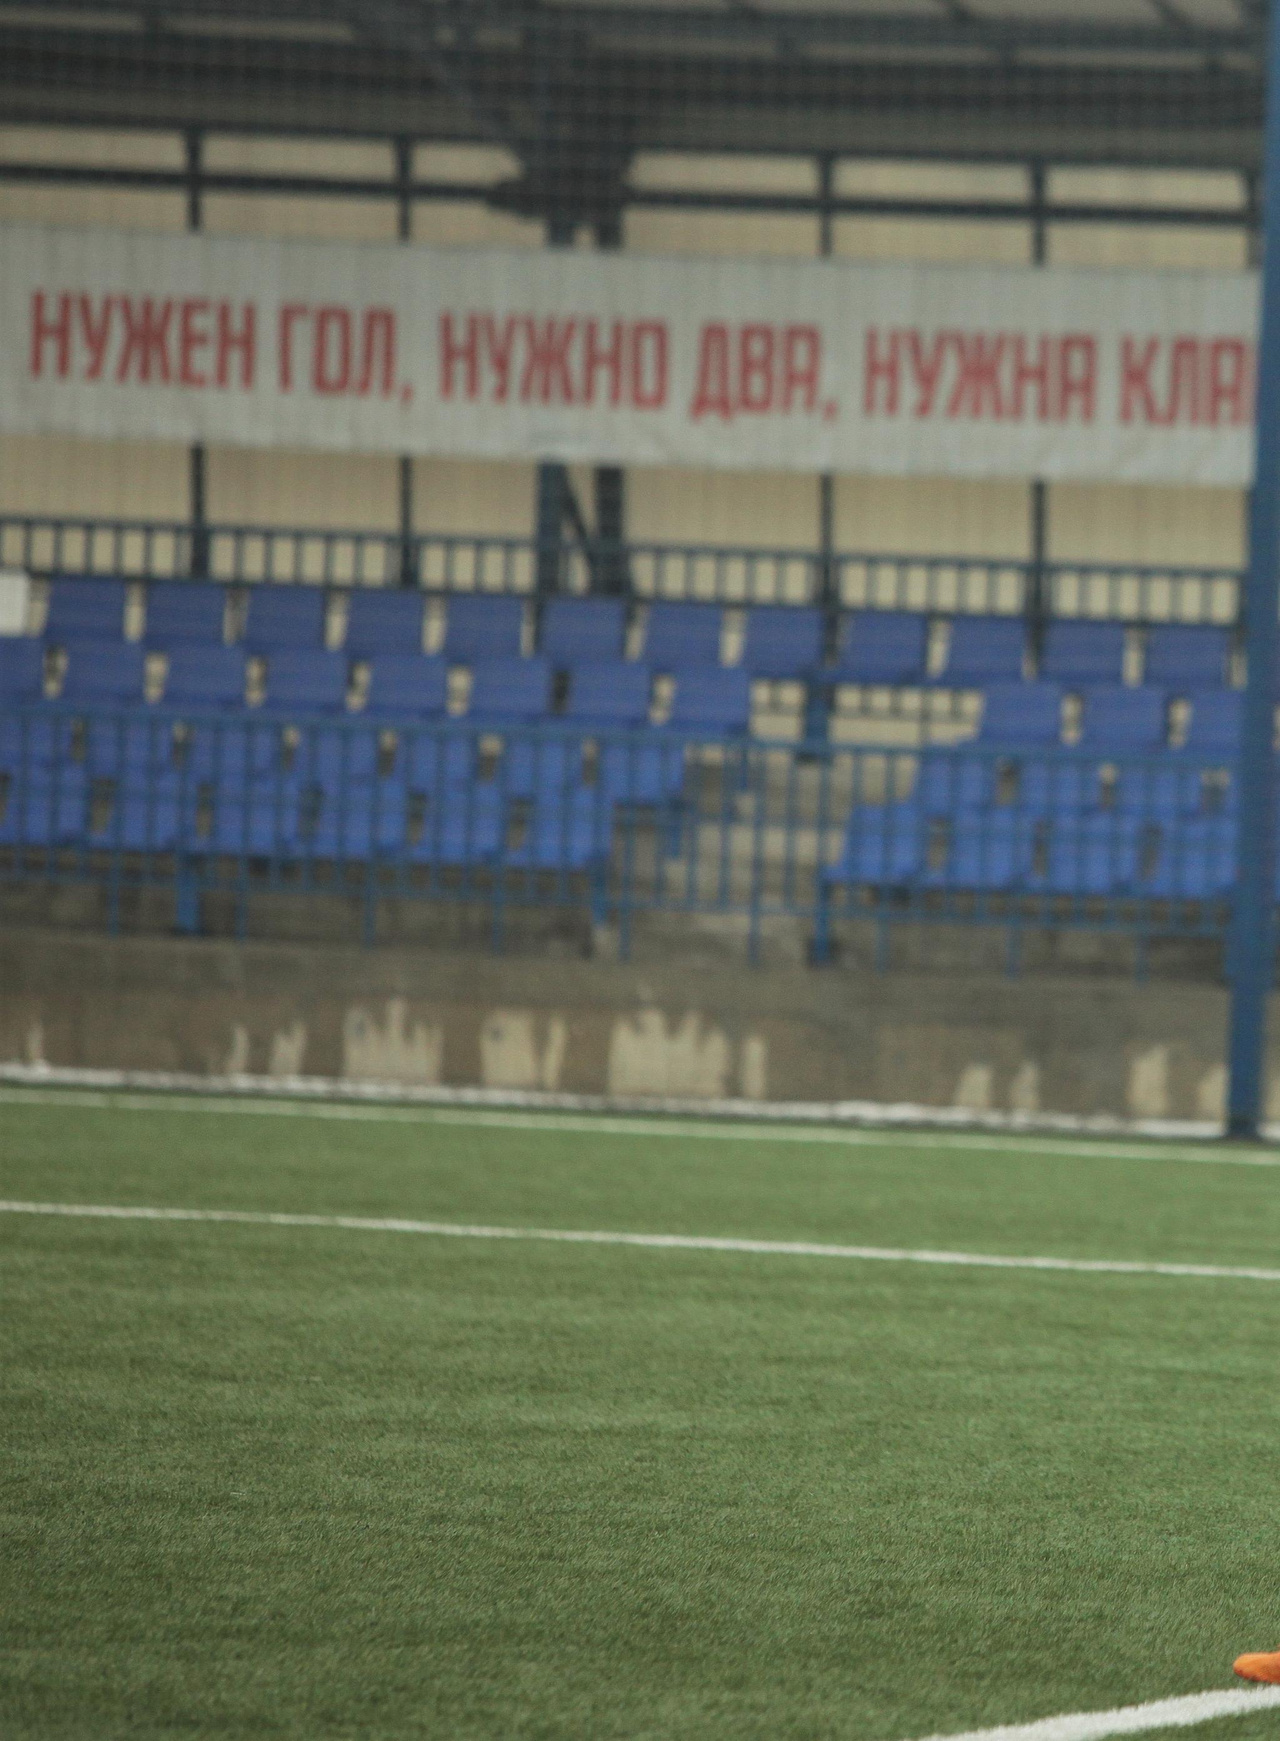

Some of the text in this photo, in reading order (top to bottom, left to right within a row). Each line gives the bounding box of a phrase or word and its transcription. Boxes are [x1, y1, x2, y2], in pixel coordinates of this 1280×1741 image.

[29, 291, 256, 391] НУЖЕН
[277, 303, 413, 409] ГОЛ,
[438, 311, 670, 411] НУЖНО
[690, 321, 838, 422] ДВА,
[862, 327, 1098, 423] НУЖНА
